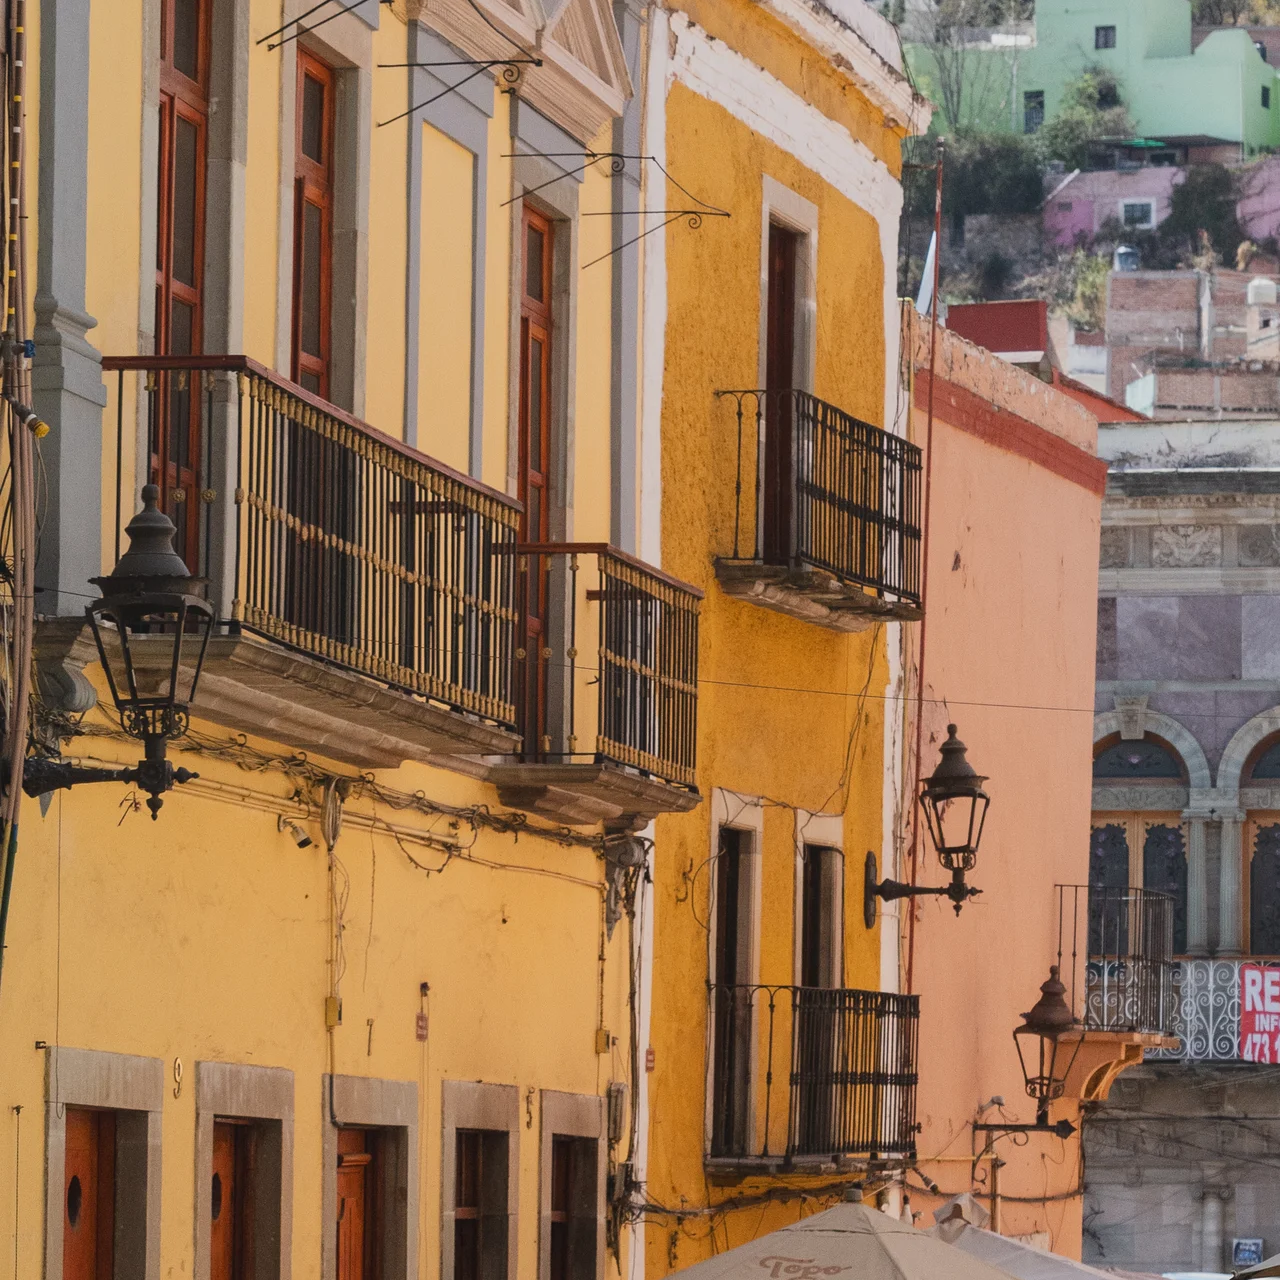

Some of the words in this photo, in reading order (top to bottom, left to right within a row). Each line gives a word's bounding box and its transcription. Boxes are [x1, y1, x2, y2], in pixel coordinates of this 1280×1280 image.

[1243, 1033, 1271, 1064] 473
[173, 1056, 183, 1099] 9
[759, 1255, 852, 1280] Topo
